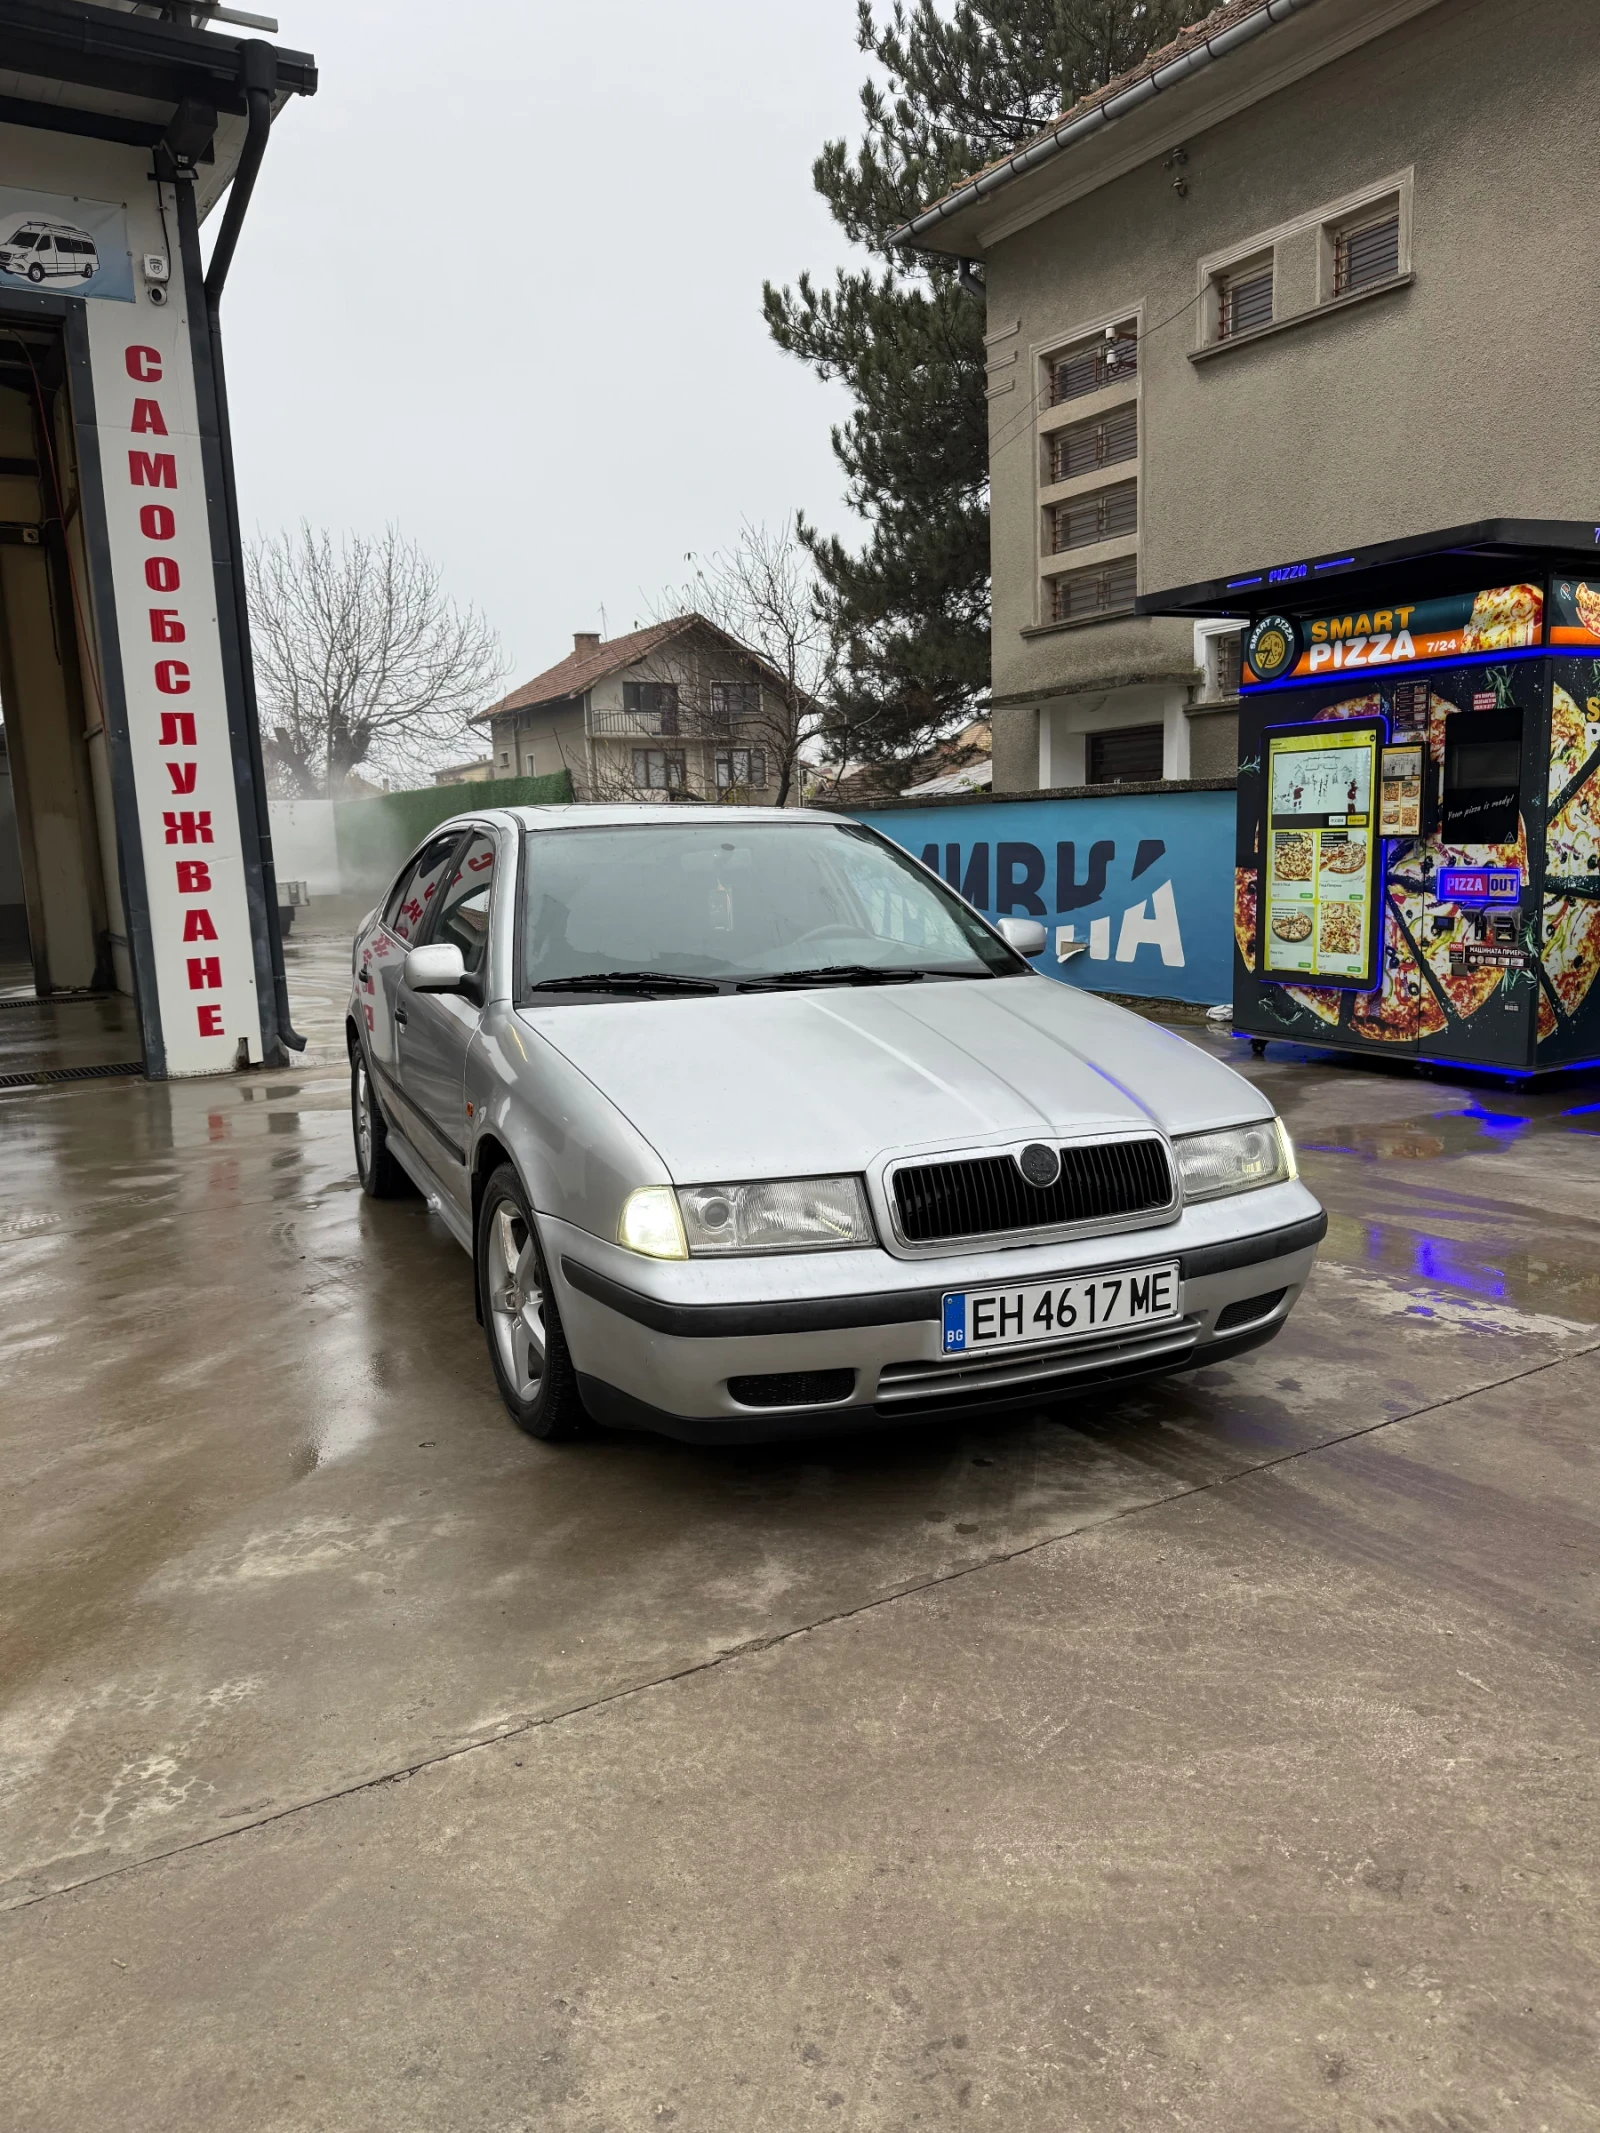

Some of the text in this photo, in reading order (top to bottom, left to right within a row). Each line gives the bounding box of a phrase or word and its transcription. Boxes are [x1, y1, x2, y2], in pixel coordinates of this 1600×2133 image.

[1250, 617, 1294, 650] SMART PIZZA
[1311, 605, 1416, 643] SMART
[1309, 630, 1457, 671] PIZZA 7/24
[125, 345, 226, 1038] САМООБСЛУЖВАНЕ
[1447, 793, 1515, 821] Your pizza is ready!
[1446, 873, 1516, 895] PIZZA OUT
[1469, 946, 1501, 955] МАШИНАТА
[973, 1271, 1173, 1340] EH 4617 ME
[947, 1329, 963, 1343] BG
